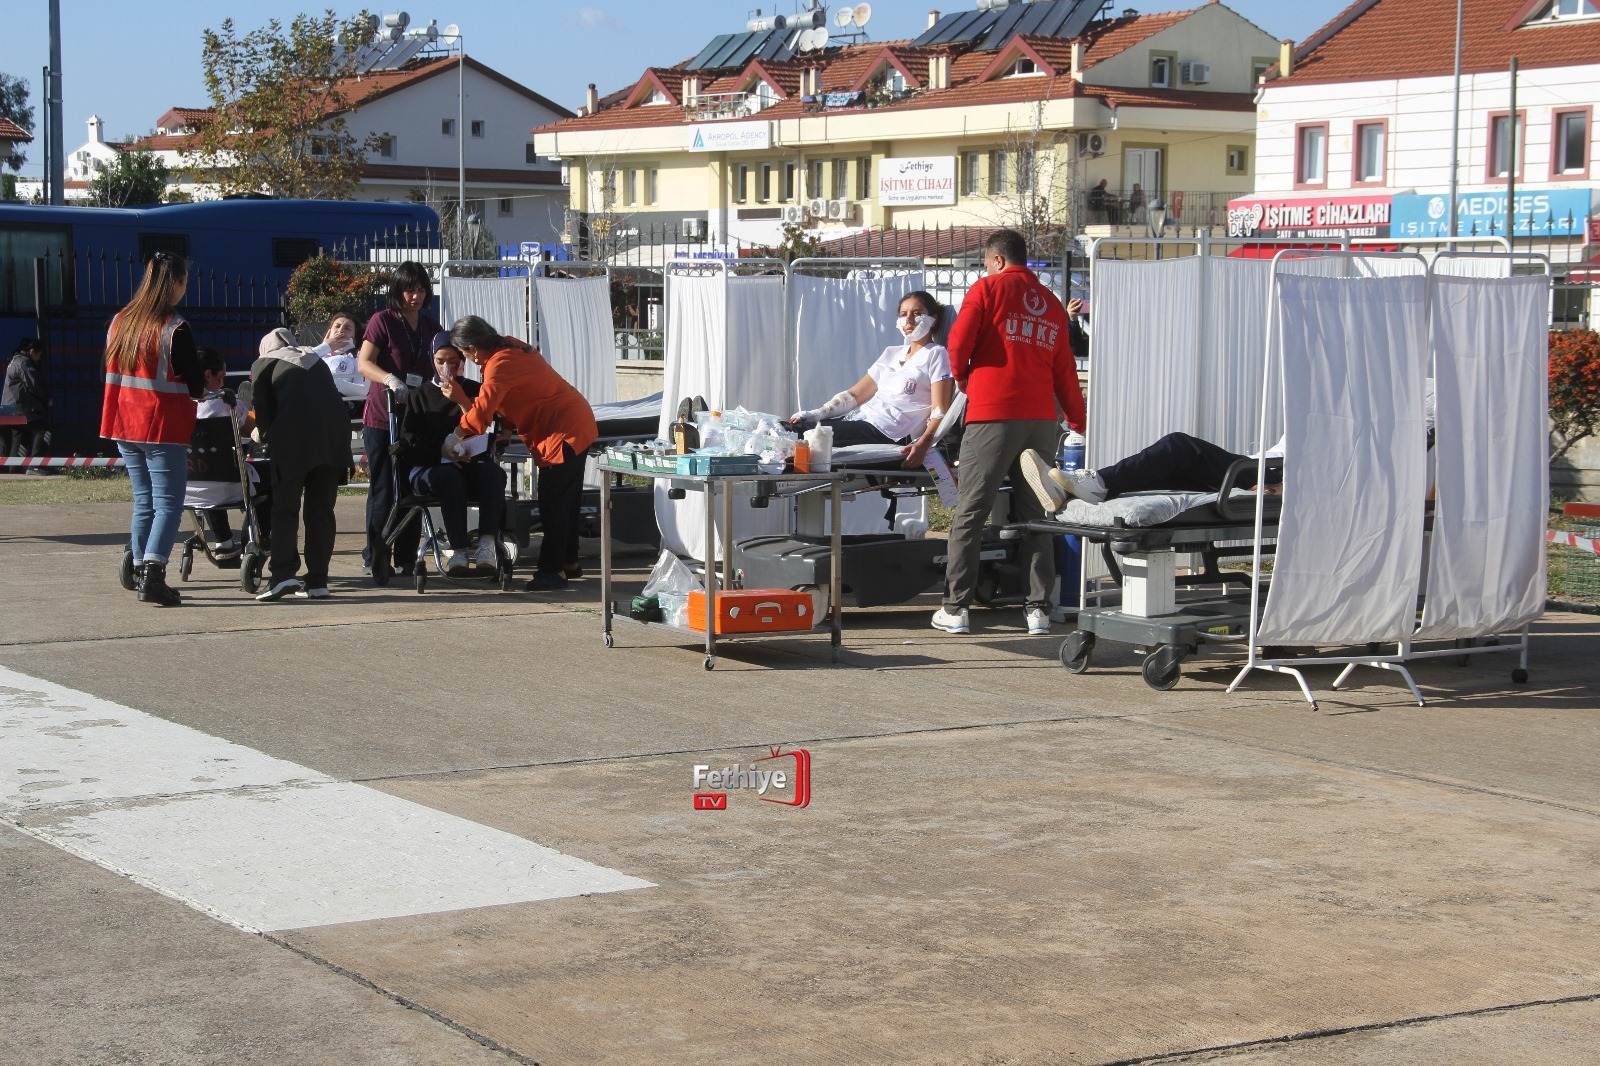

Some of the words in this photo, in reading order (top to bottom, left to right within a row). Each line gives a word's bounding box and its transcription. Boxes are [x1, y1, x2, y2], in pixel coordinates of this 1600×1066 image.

[741, 131, 767, 140] AGENCY
[880, 177, 915, 193] İŞİTME
[916, 176, 953, 190] CİHAZI
[1265, 203, 1313, 228] İŞİTME
[1316, 201, 1390, 225] CİHAZLARI
[1005, 318, 1058, 345] UMKE
